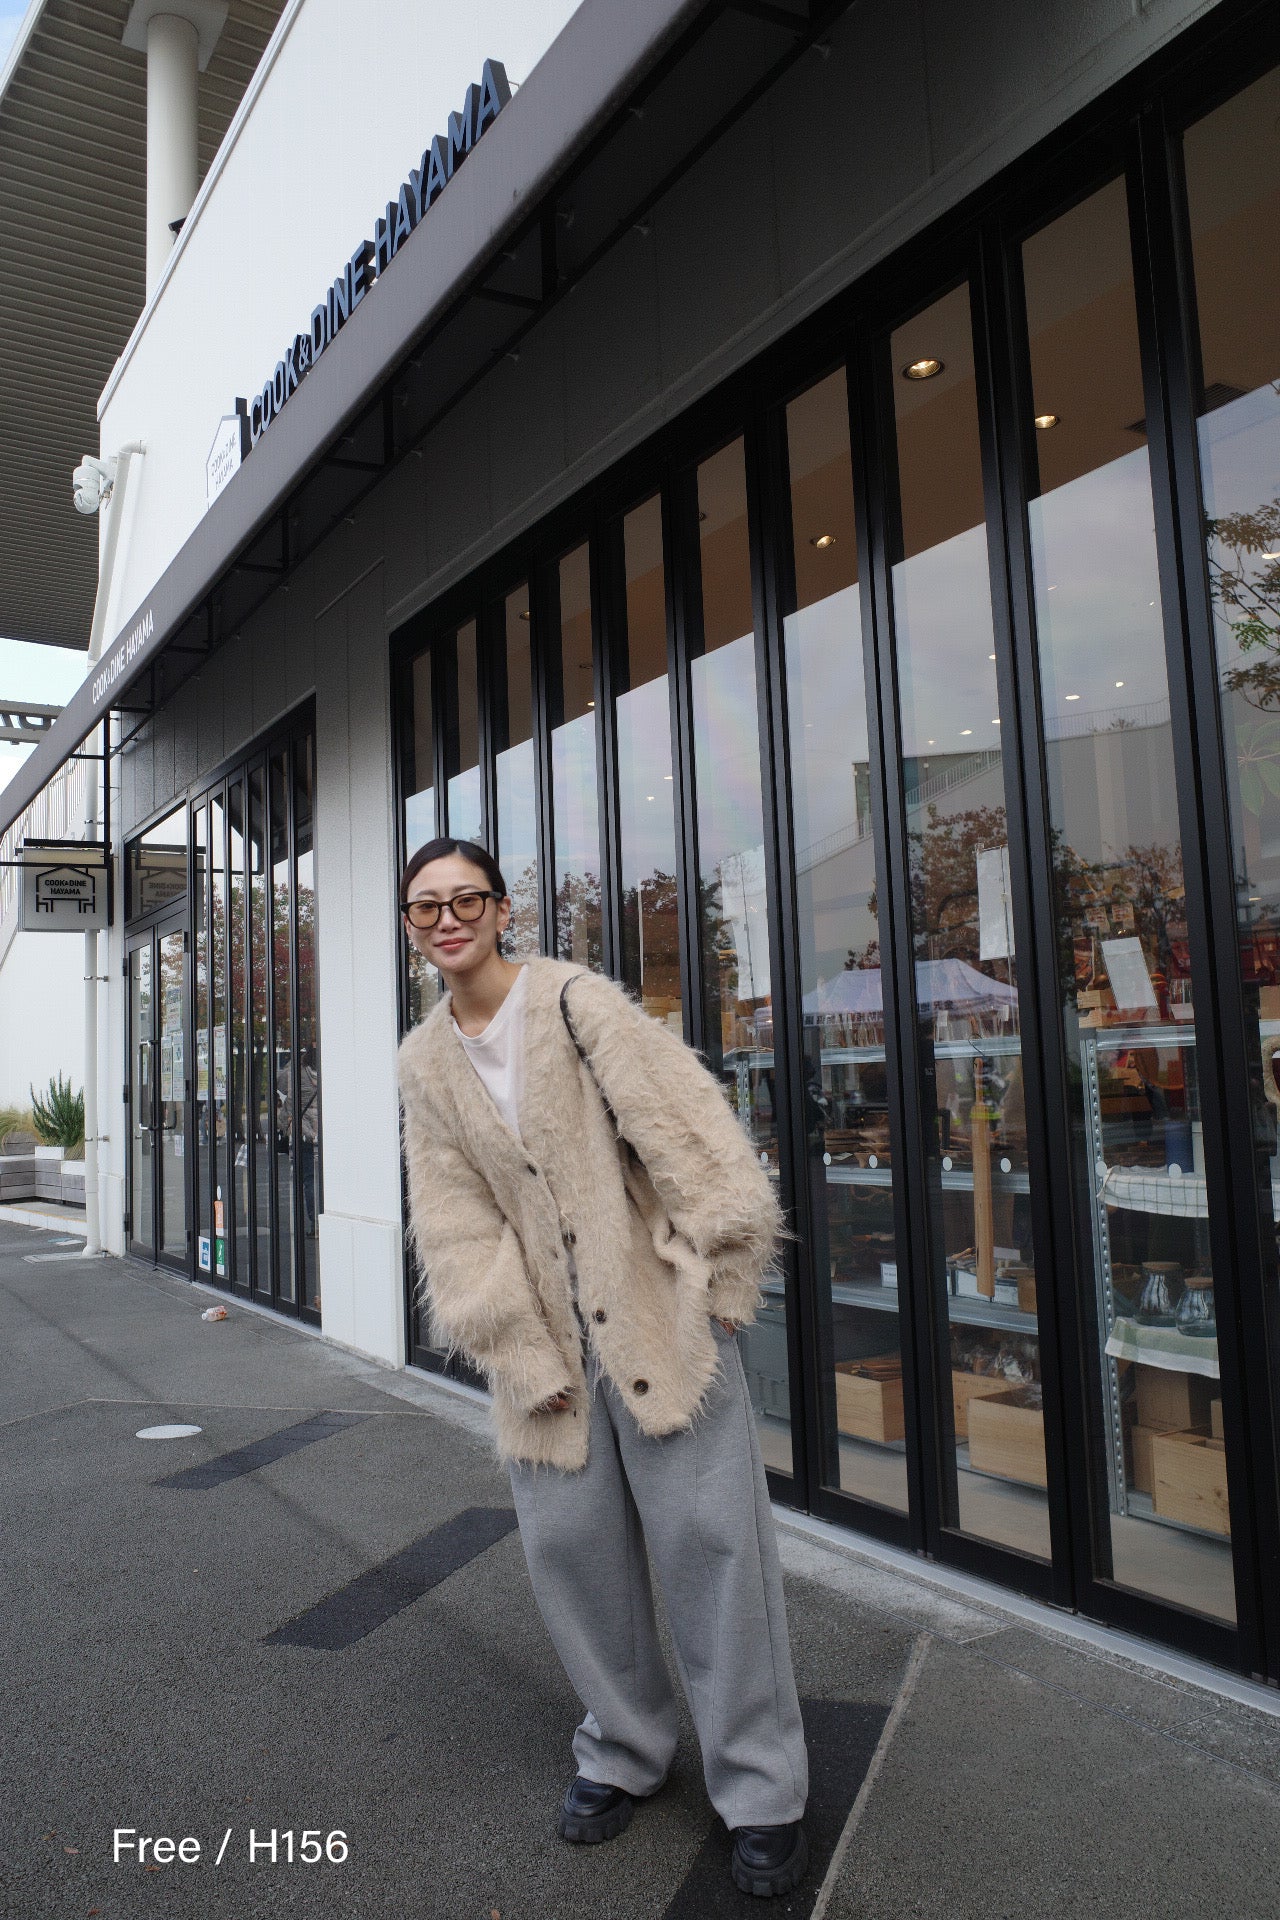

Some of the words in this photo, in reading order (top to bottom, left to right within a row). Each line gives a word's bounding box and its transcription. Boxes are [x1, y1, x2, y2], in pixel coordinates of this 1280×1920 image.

[250, 240, 370, 446] COOK&DINE
[375, 58, 506, 279] HAYAMA
[92, 645, 126, 705] COOK&DINE
[126, 609, 154, 665] HAYAMA
[44, 879, 87, 888] COOK&DINE
[50, 887, 81, 895] HAYAMA
